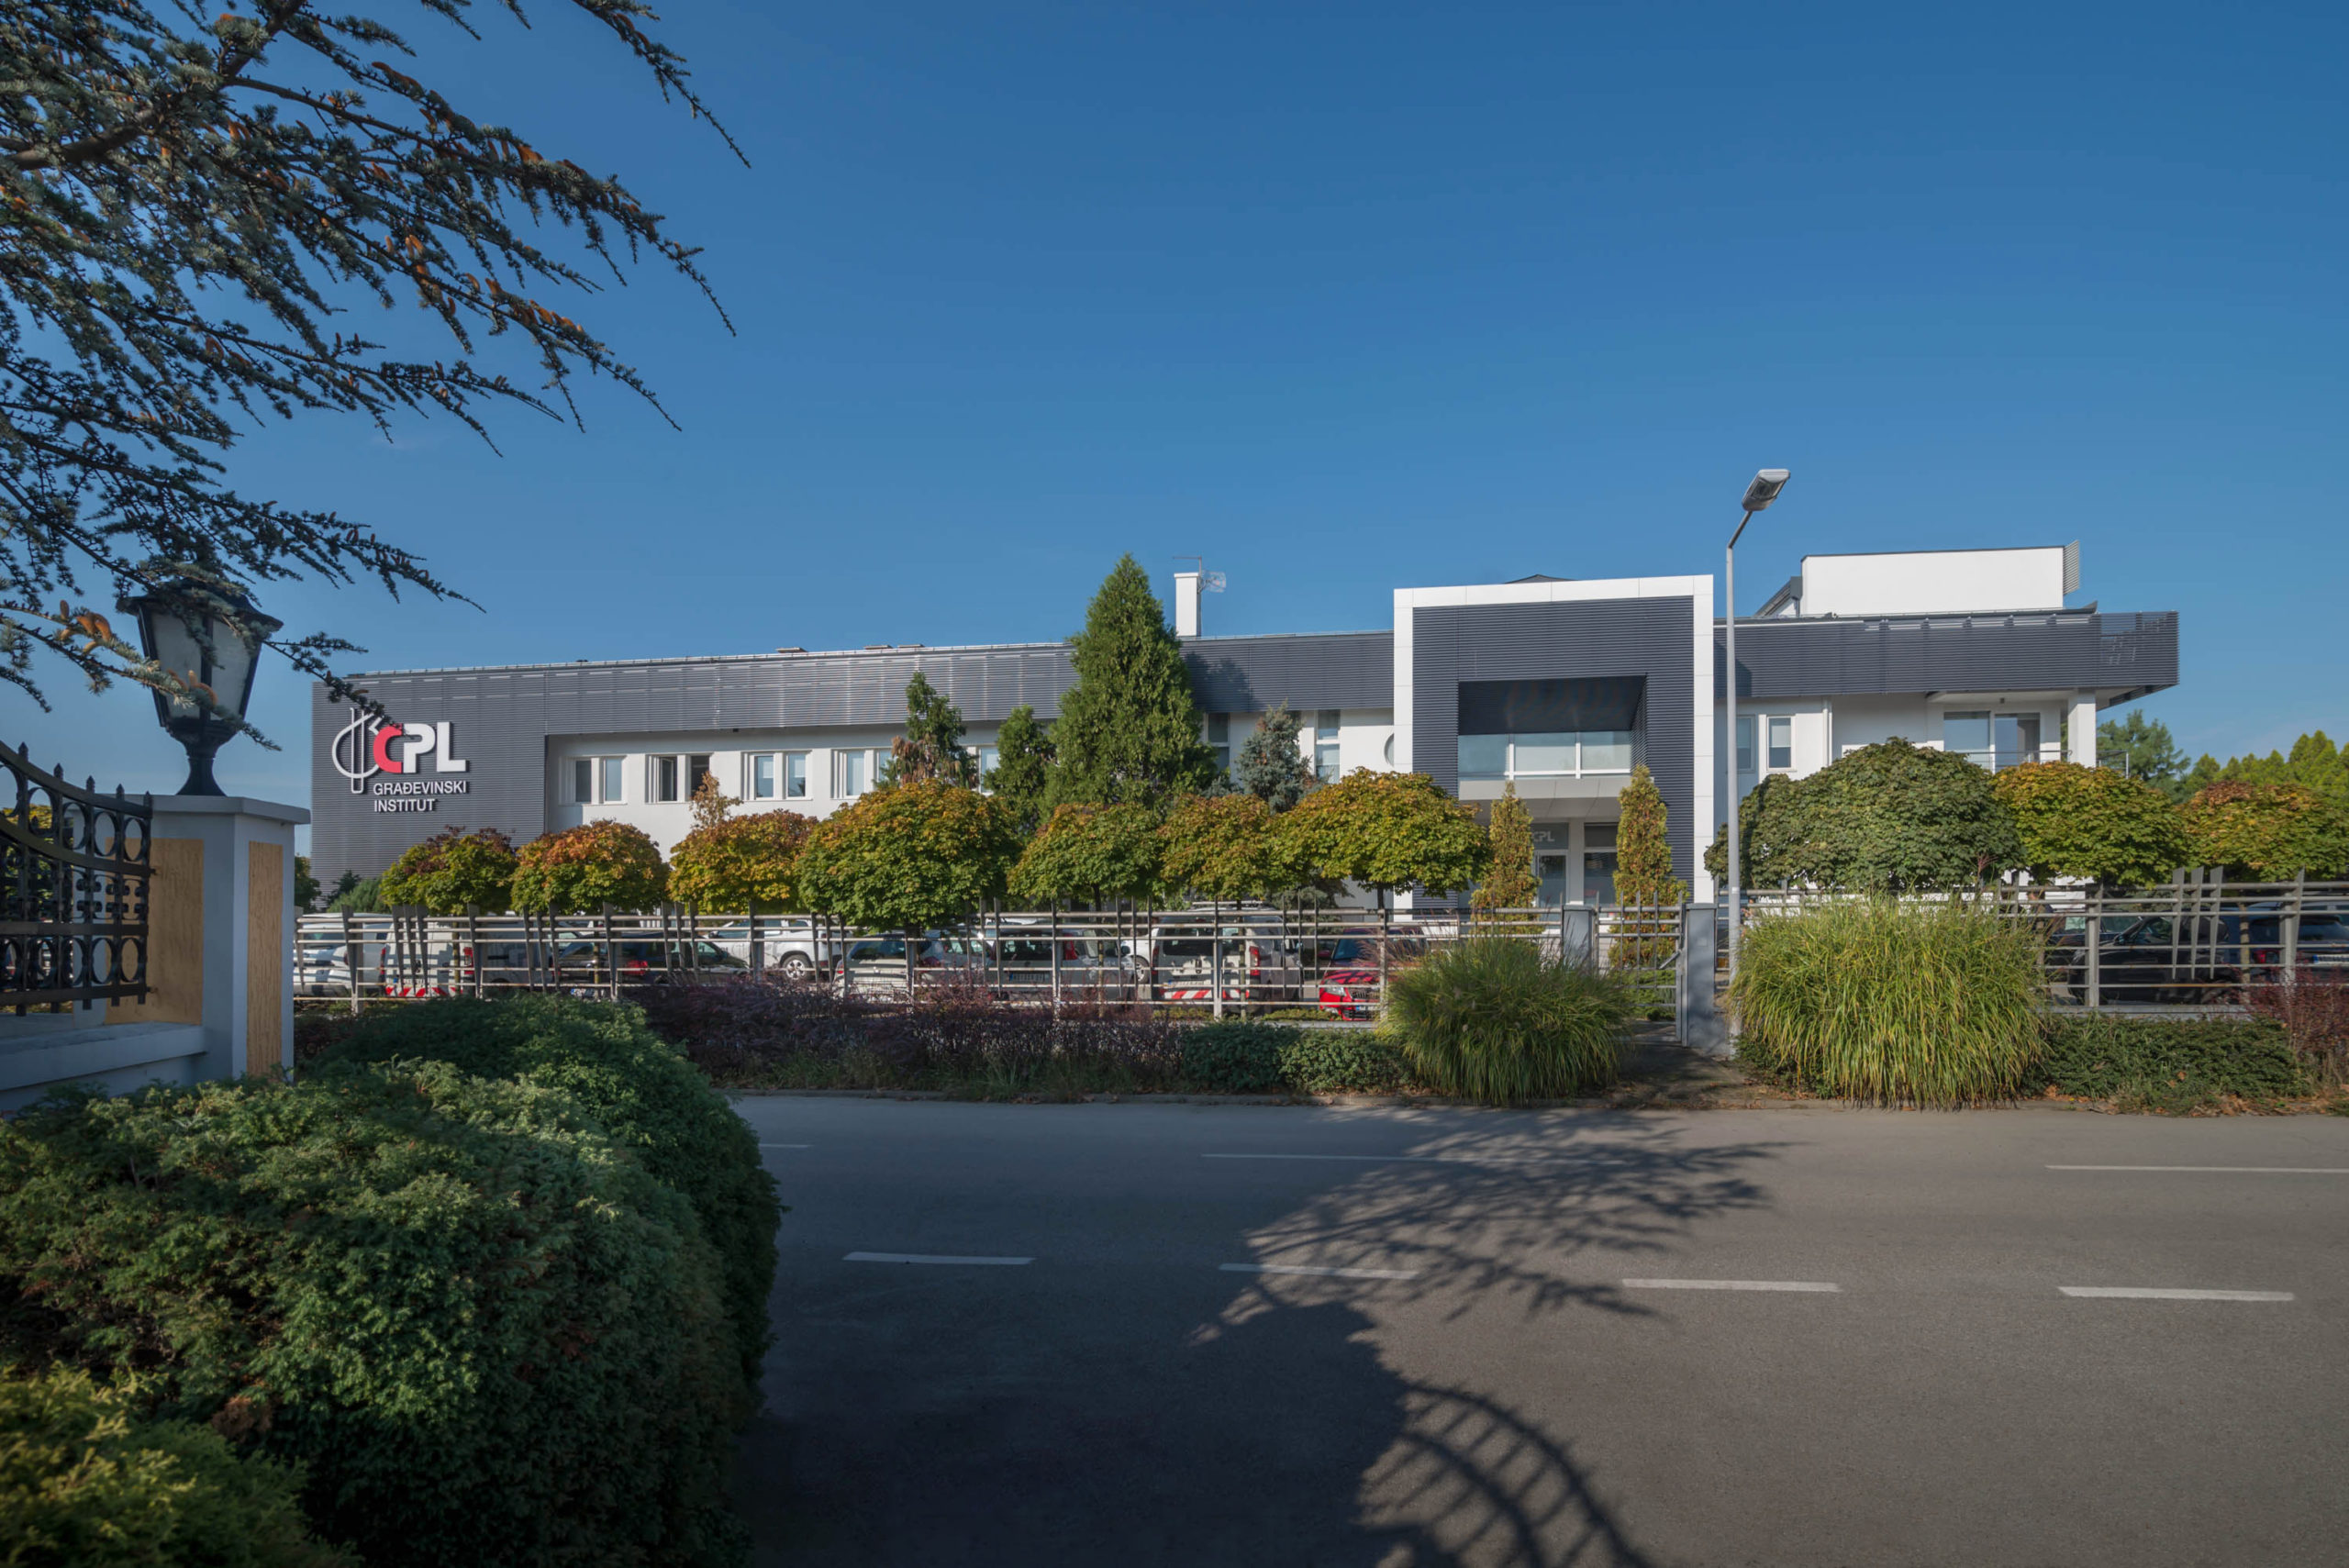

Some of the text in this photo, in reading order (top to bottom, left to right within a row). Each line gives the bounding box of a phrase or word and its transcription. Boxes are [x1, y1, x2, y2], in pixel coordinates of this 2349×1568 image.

[373, 722, 466, 773] CPL
[373, 781, 467, 795] GRAĐEVINSKI
[374, 798, 436, 812] INSTITUT
